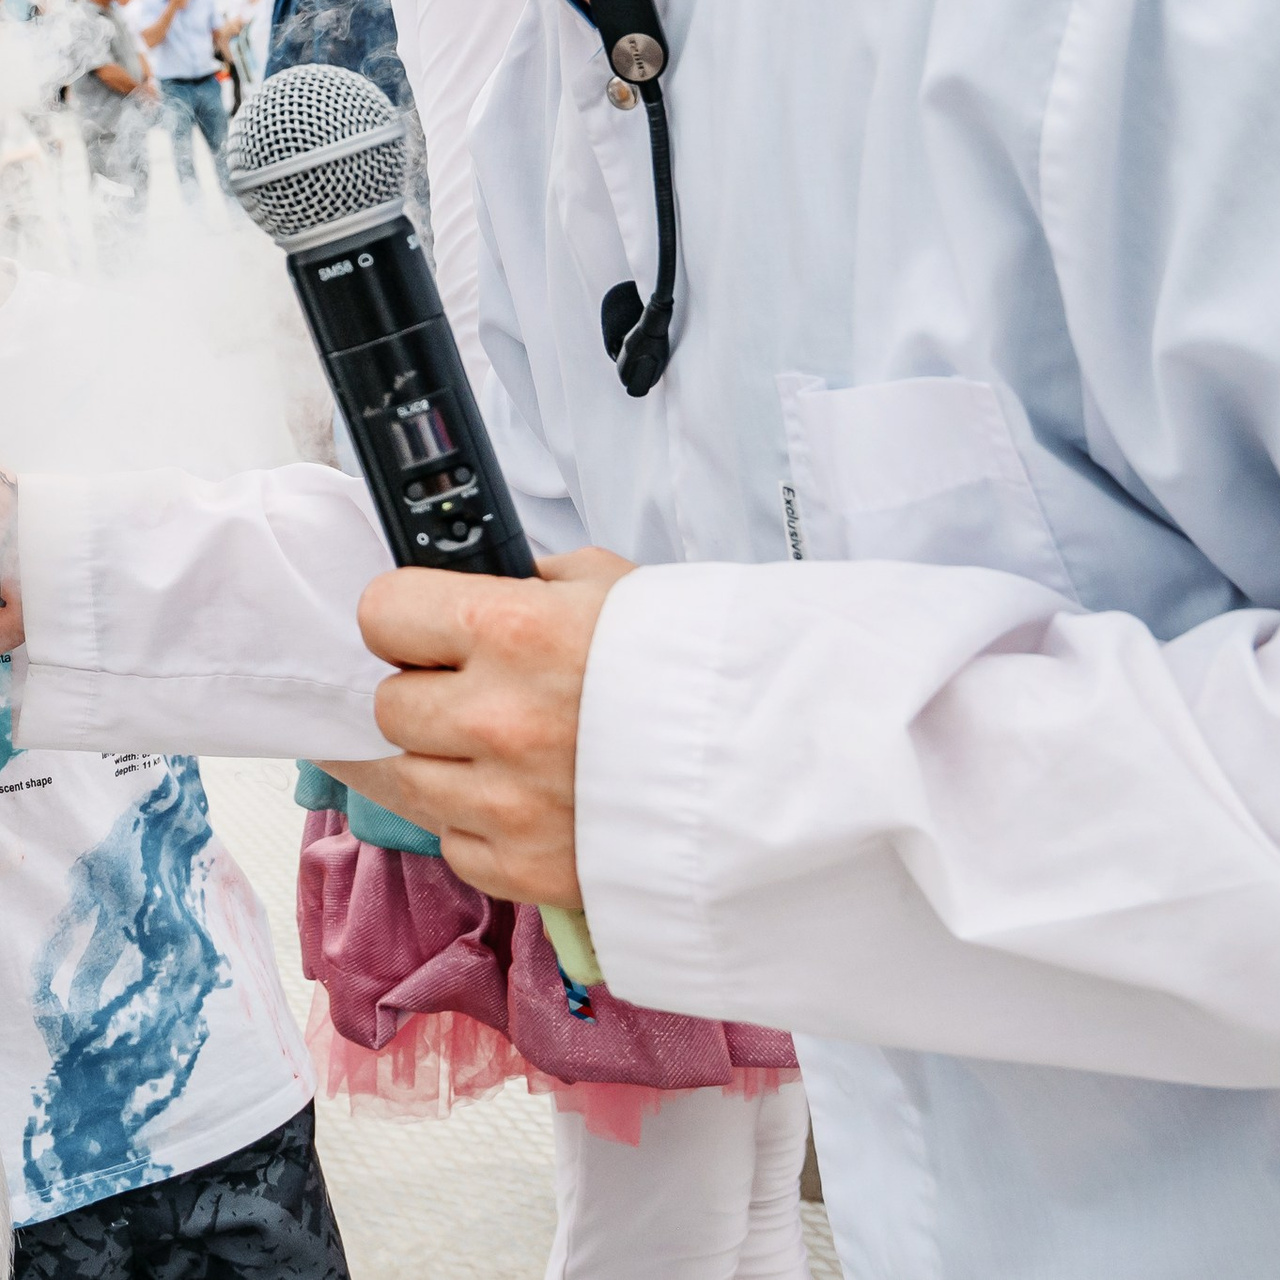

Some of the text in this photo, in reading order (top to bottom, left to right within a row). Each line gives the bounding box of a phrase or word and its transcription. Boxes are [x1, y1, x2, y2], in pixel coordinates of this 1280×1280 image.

[782, 486, 803, 561] Exclusive
[114, 753, 139, 765] width:
[114, 764, 139, 777] depth:
[25, 775, 53, 790] shape
